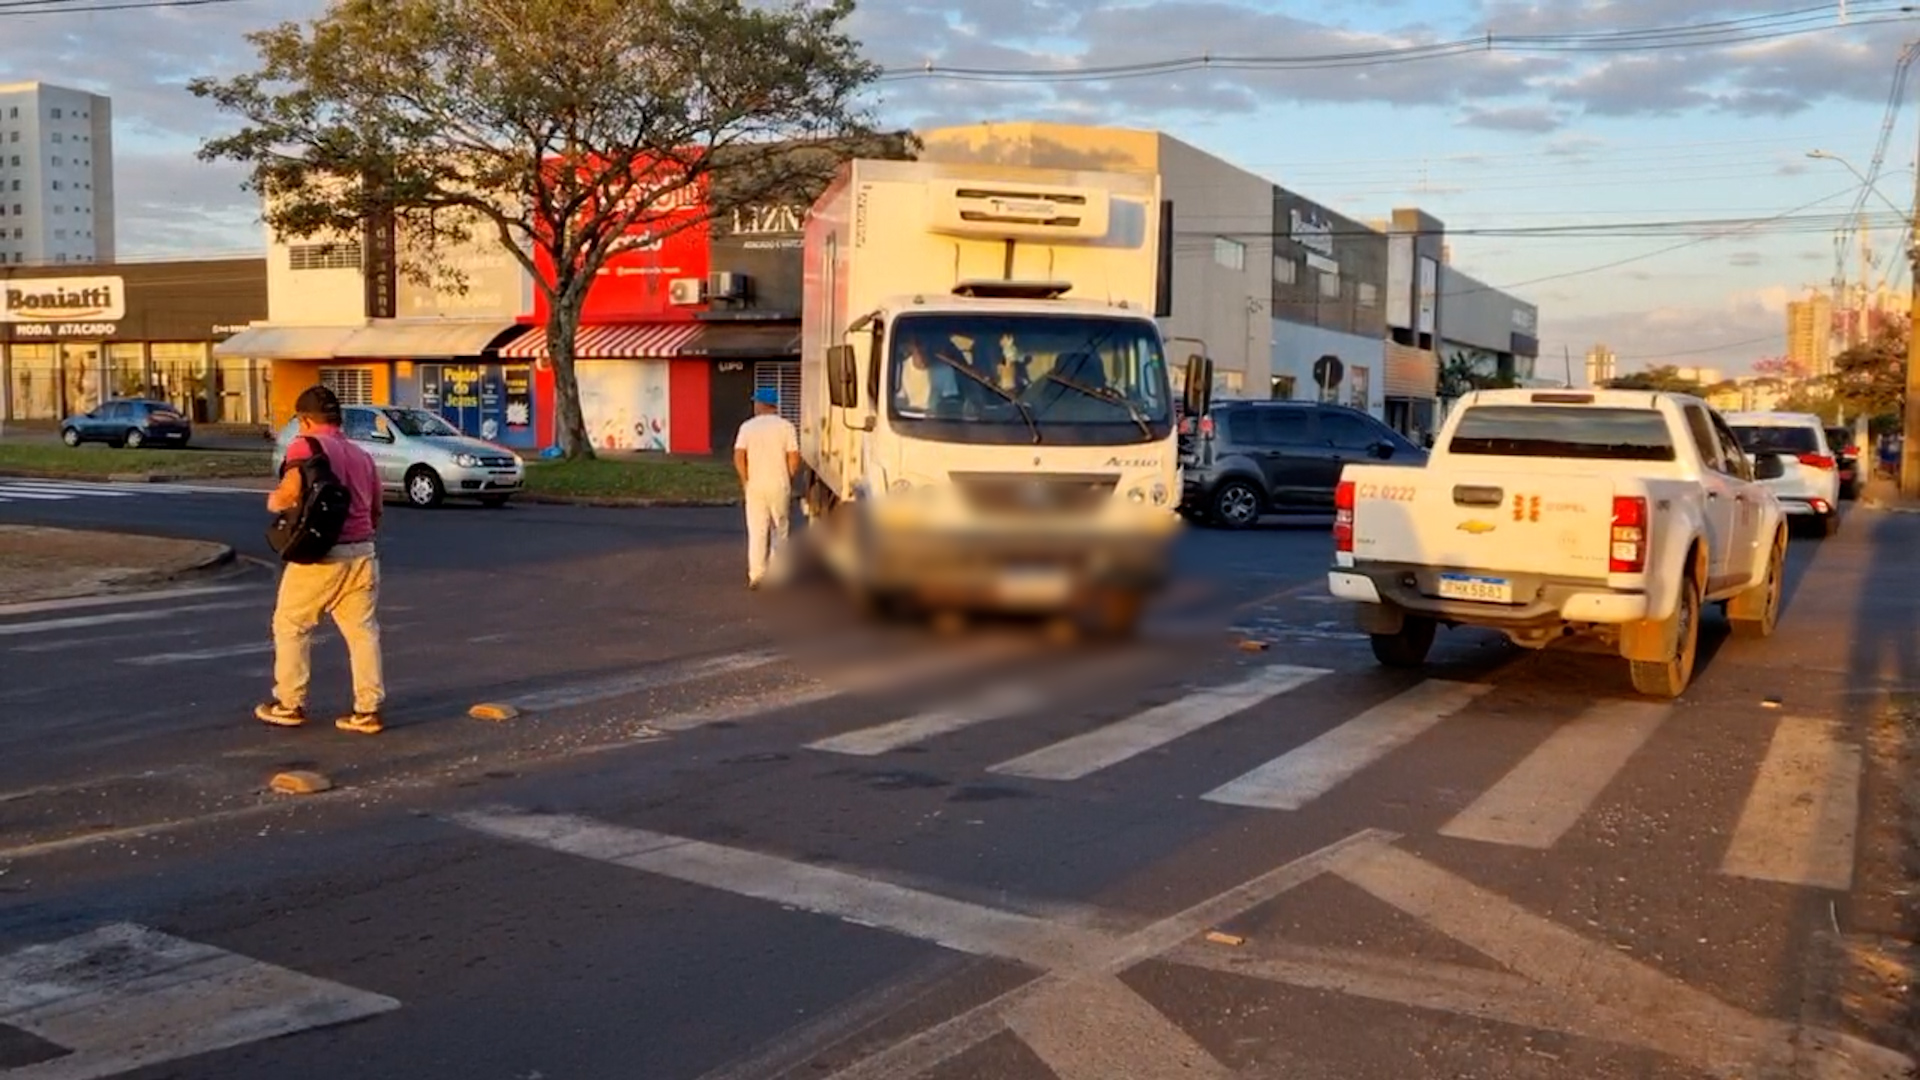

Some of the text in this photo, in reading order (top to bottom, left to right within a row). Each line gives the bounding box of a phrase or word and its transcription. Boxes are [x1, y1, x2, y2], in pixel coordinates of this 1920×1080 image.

[6, 286, 112, 310] Boniatti
[16, 323, 116, 336] MODA ATACADO
